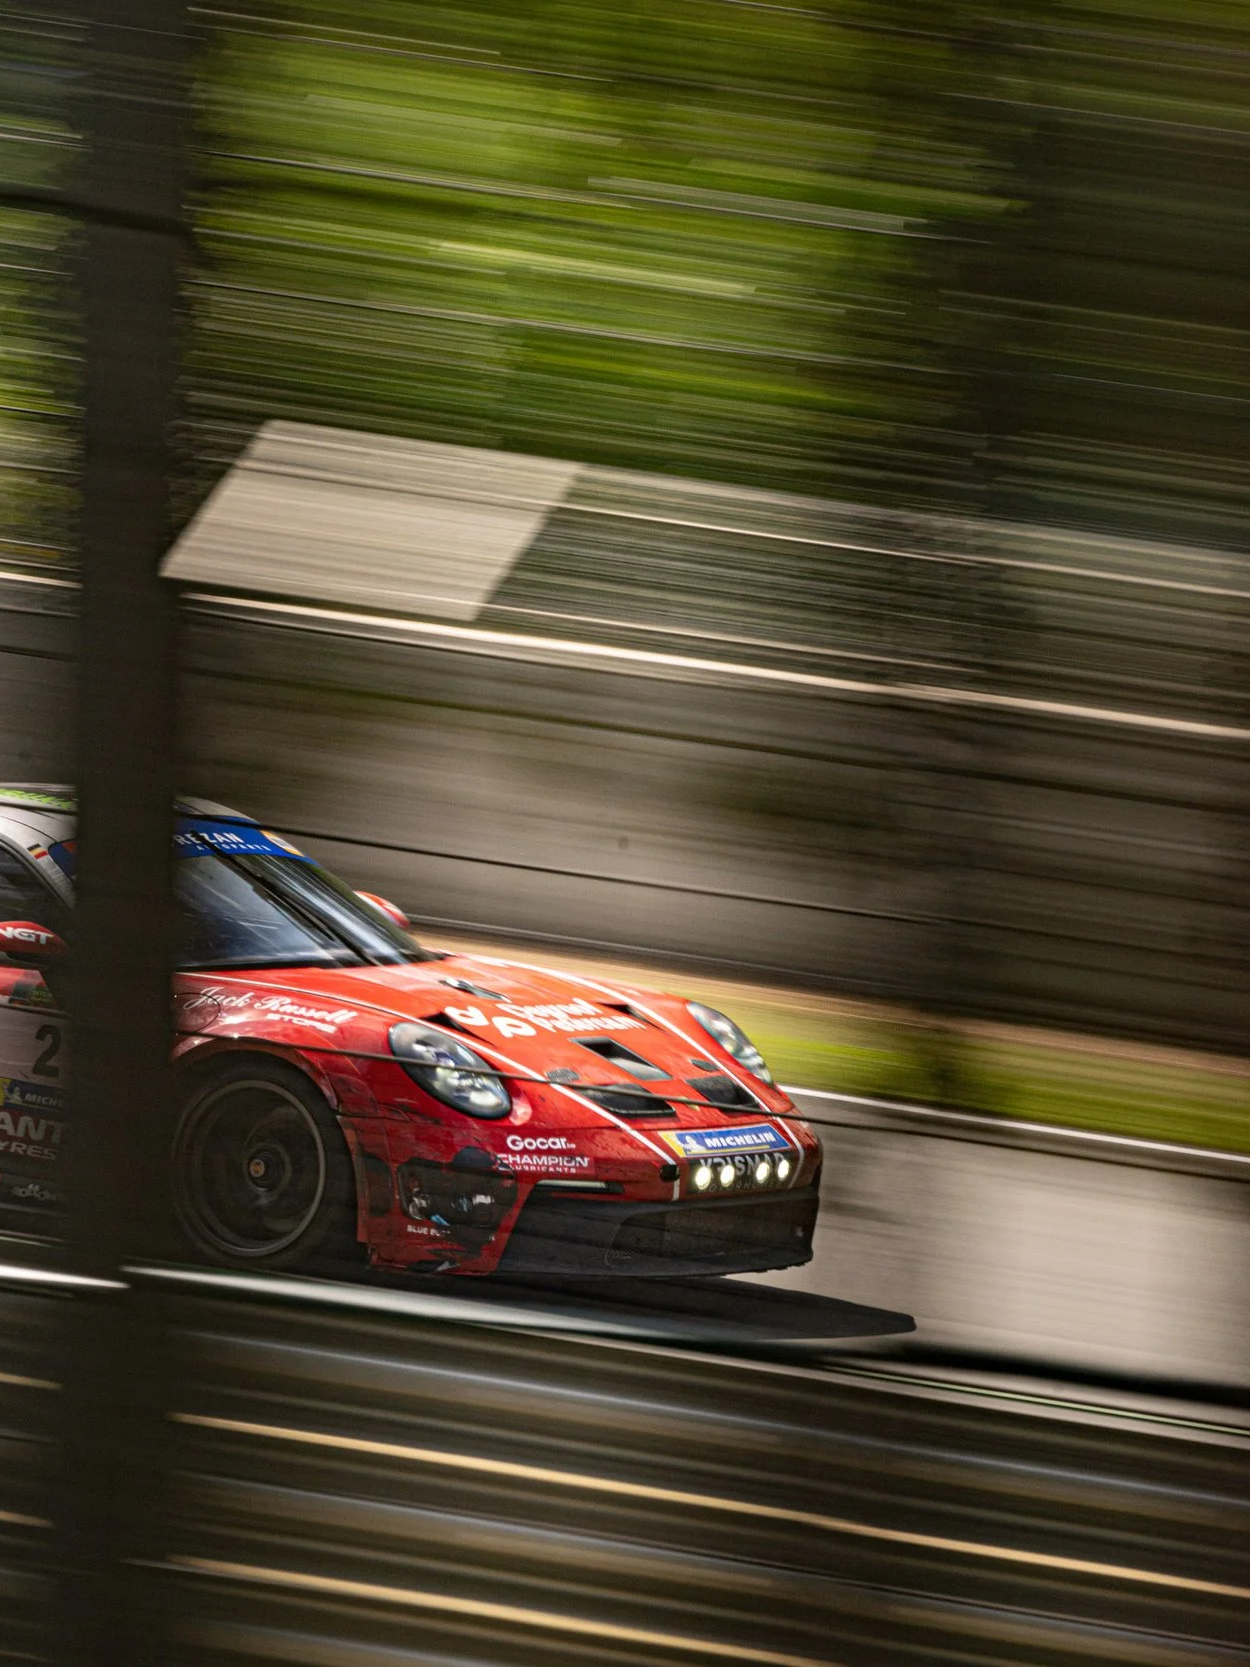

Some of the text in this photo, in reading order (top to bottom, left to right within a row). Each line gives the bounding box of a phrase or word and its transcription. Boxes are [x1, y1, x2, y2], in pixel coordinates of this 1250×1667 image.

[173, 831, 245, 846] REZAN
[196, 843, 272, 851] ATOPARTS
[183, 986, 358, 1024] Jack Russell
[265, 1012, 338, 1034] STORE
[704, 1131, 777, 1148] MICHELIN
[496, 1153, 590, 1168] CHAMPION
[406, 1224, 429, 1235] BLUE
